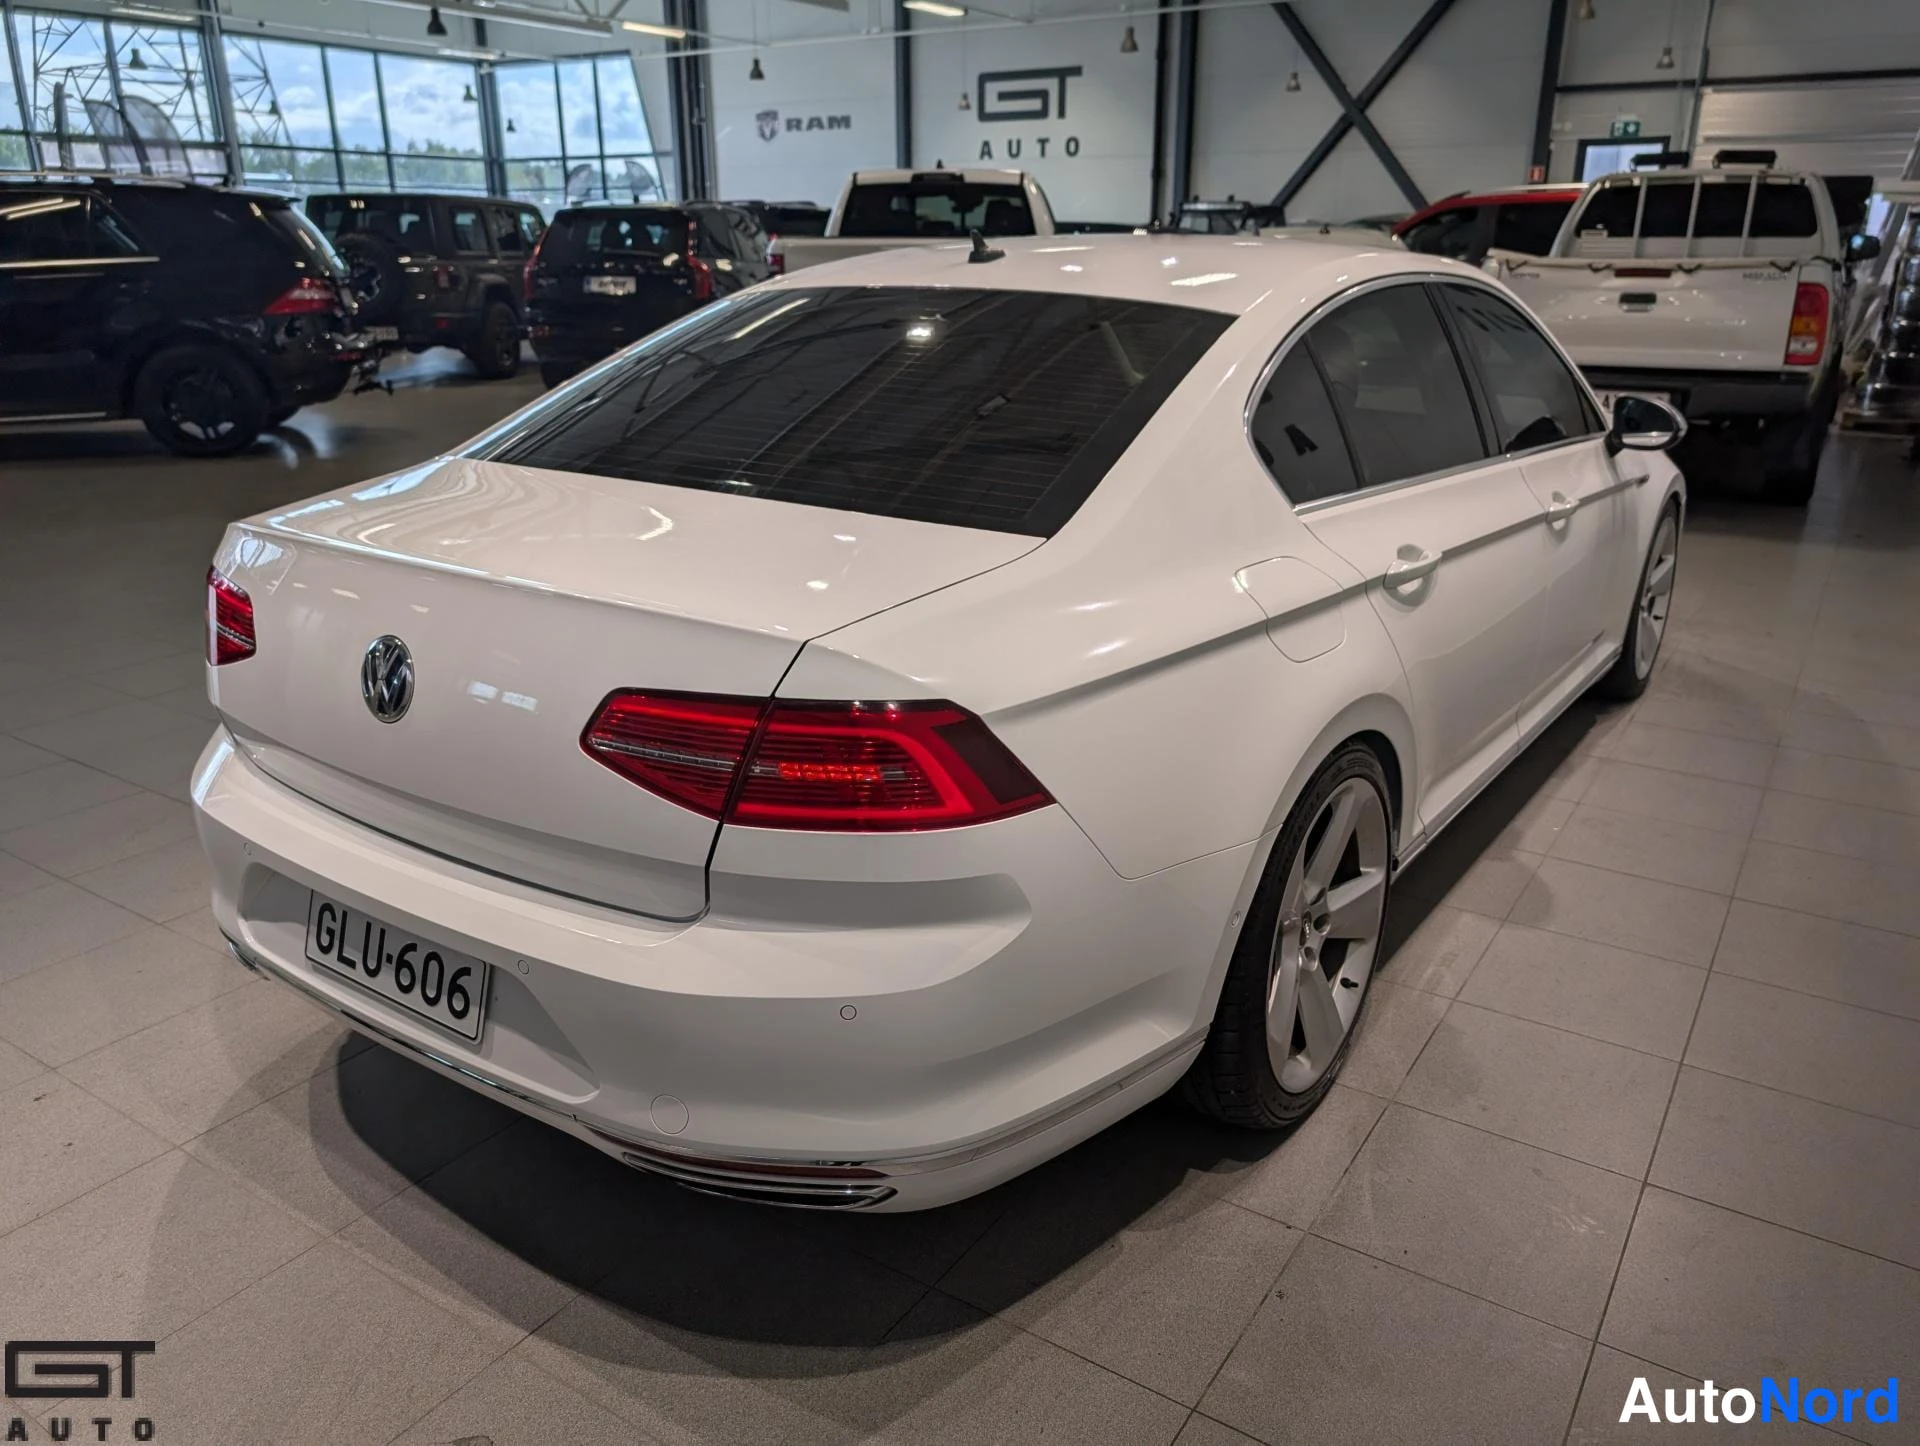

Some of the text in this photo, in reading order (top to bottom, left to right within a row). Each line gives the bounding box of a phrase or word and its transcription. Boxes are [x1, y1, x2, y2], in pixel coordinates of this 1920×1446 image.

[977, 66, 1083, 122] GT
[785, 115, 852, 132] RAM
[978, 136, 1080, 160] AUTO
[315, 902, 473, 1020] GLU-606
